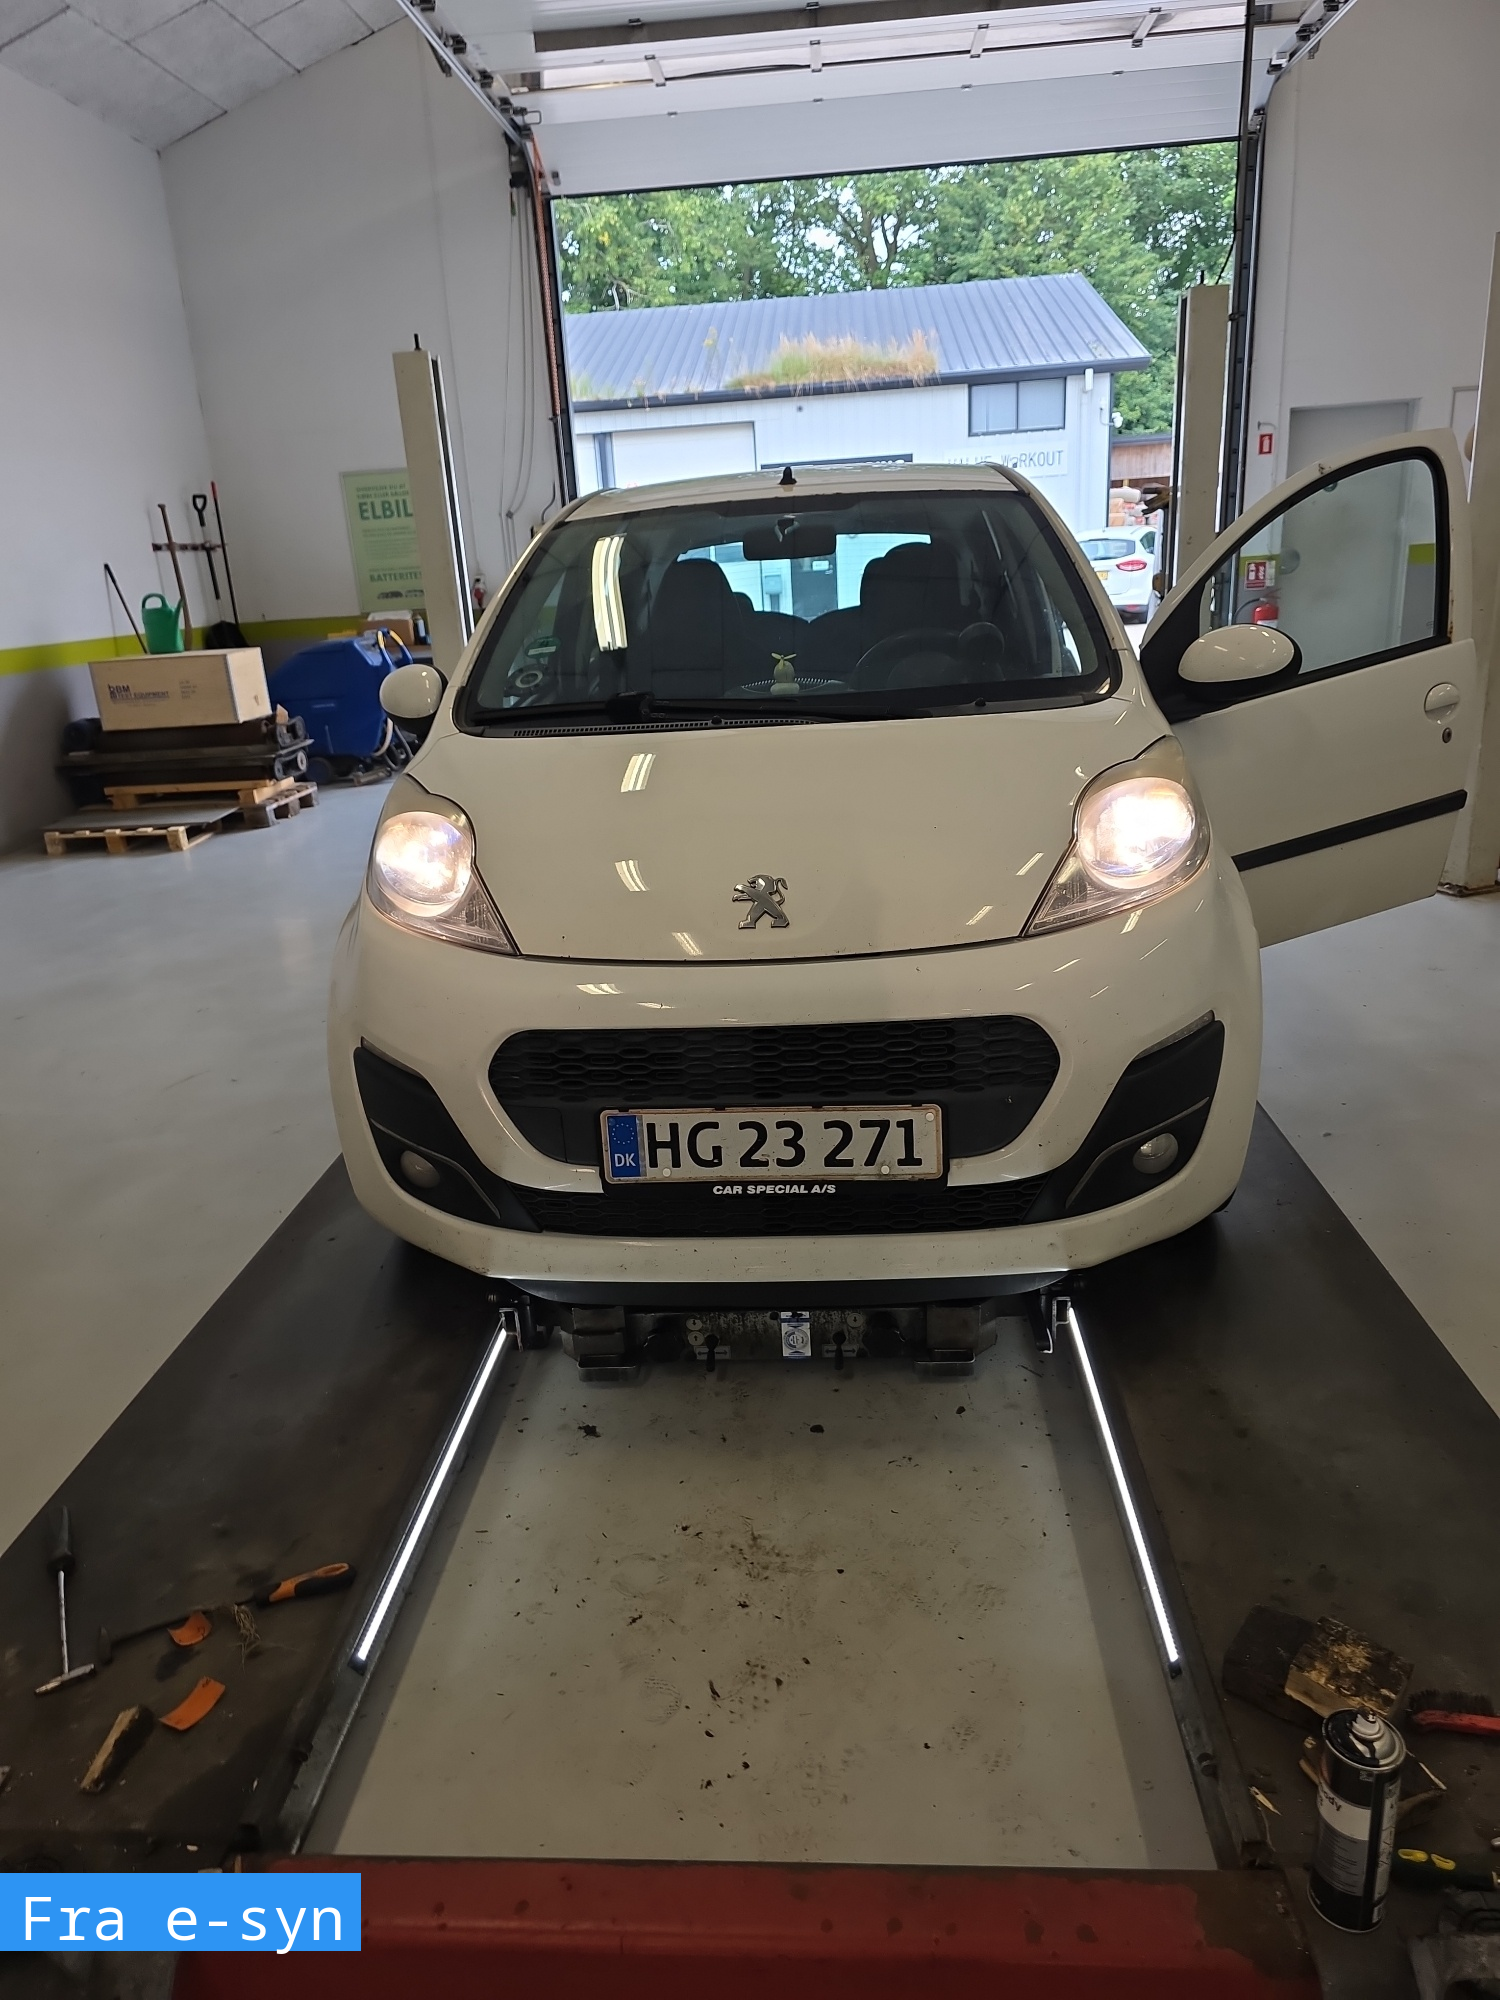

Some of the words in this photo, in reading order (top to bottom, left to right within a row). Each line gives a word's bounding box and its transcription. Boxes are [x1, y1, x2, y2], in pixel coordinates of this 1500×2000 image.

[358, 498, 413, 520] ELBIL
[646, 1121, 723, 1169] HG
[738, 1120, 806, 1168] 23
[823, 1118, 923, 1168] 271
[614, 1153, 636, 1168] DK
[712, 1185, 743, 1195] CAR
[746, 1184, 809, 1195] SPECIAL
[811, 1184, 837, 1194] A/S
